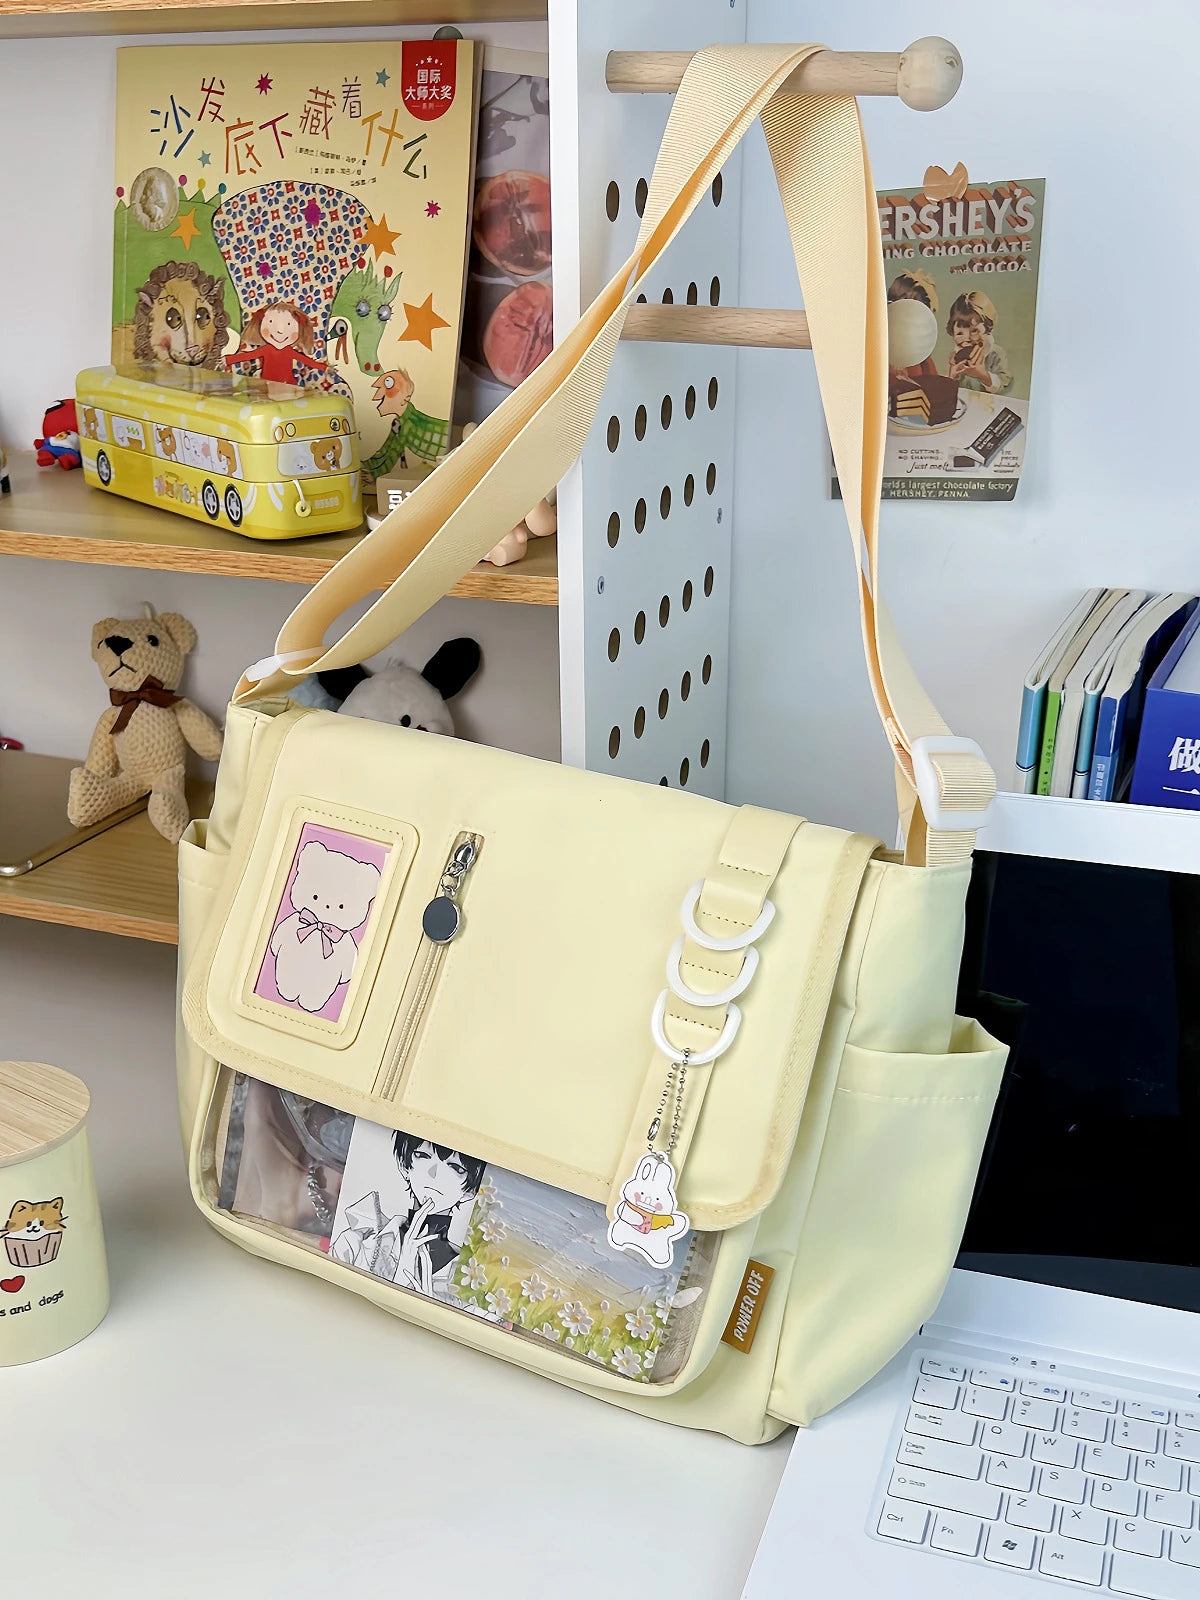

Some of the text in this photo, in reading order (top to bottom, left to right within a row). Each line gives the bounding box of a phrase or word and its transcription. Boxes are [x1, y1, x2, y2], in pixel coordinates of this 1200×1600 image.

[417, 69, 441, 84] 国际
[405, 85, 453, 101] 大师大奖
[150, 75, 428, 180] 沙发底下藏着什么
[877, 187, 1037, 241] ERSHEY'S
[884, 240, 1033, 260] ING CHOCOLATE
[973, 259, 1032, 275] COCOA
[909, 480, 940, 492] largest
[943, 481, 985, 490] chocolate
[988, 481, 1013, 493] factory
[10, 1301, 32, 1315] and
[38, 1290, 65, 1307] dogs
[733, 1269, 764, 1342] POWER OFF
[1042, 1437, 1057, 1446] W
[1092, 1448, 1102, 1457] E
[996, 1460, 1008, 1469] A
[1144, 1459, 1156, 1469] R
[1049, 1471, 1060, 1480] S
[1101, 1482, 1112, 1492] D
[1016, 1497, 1028, 1507] Z
[1155, 1494, 1165, 1502] F
[1071, 1509, 1082, 1520] X
[1124, 1522, 1136, 1532] C
[1180, 1534, 1192, 1544] V
